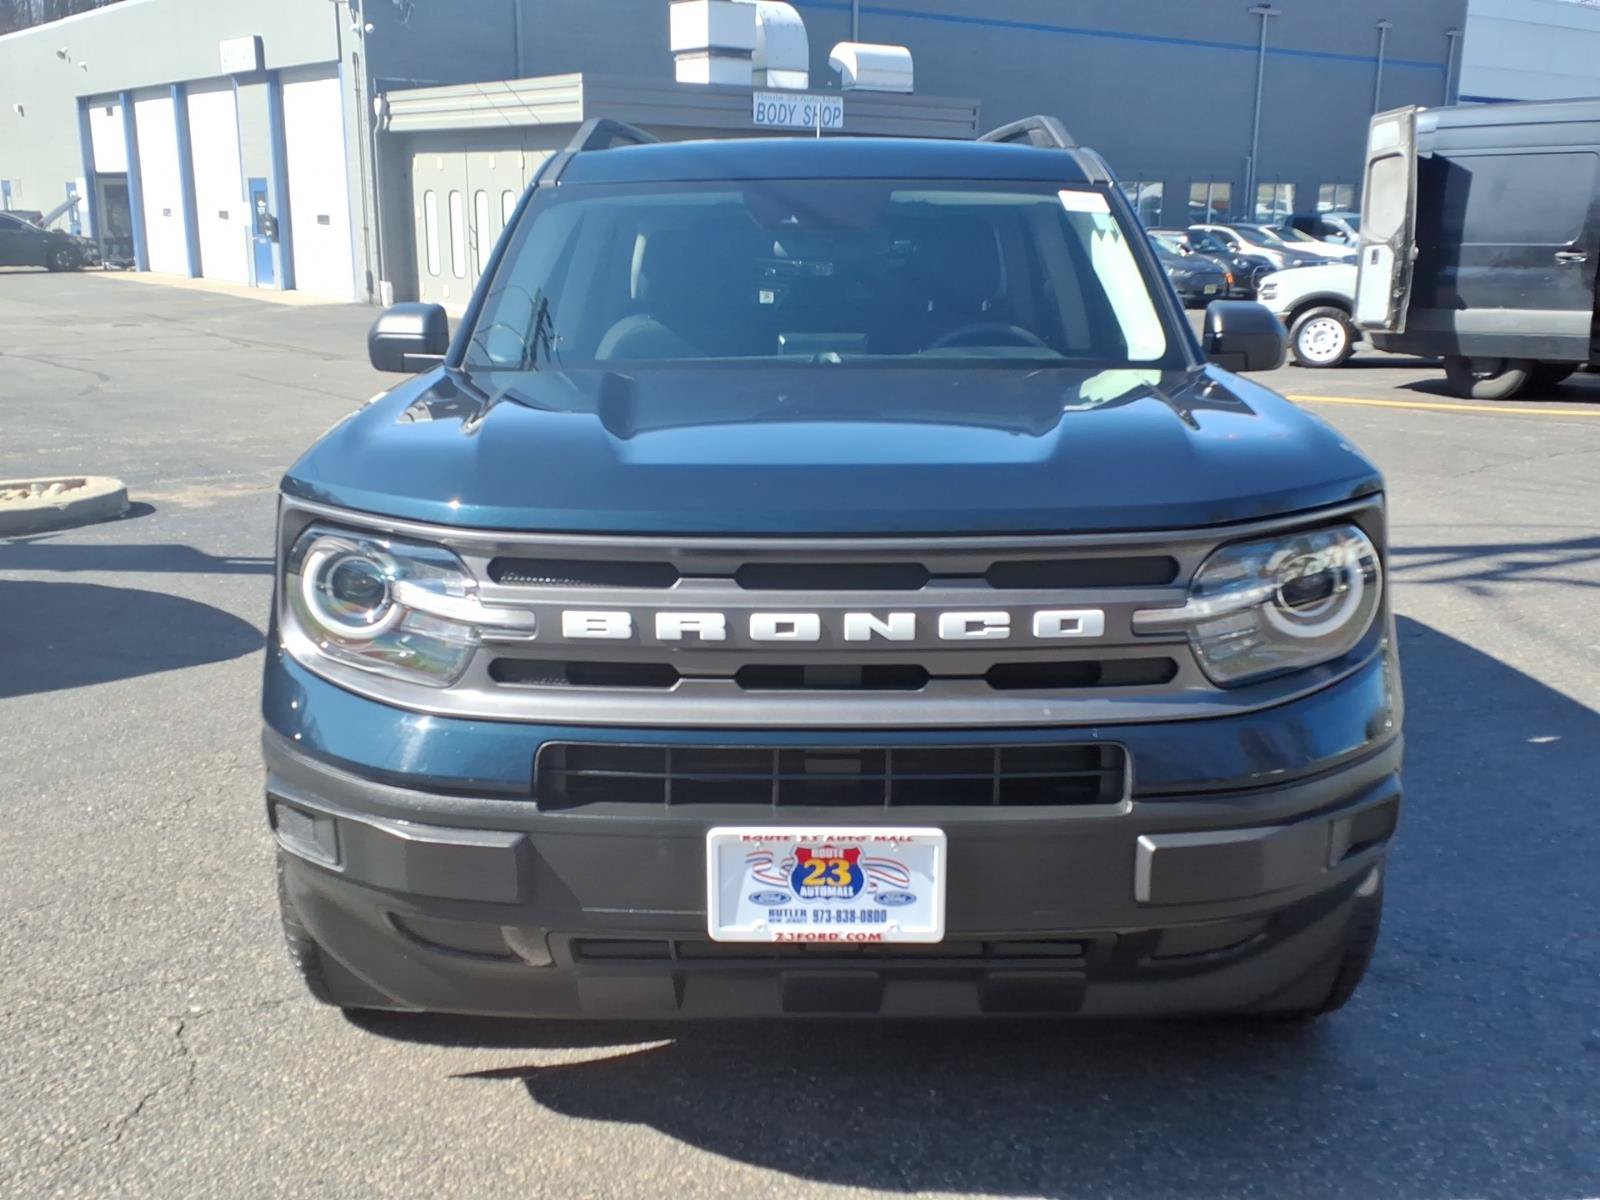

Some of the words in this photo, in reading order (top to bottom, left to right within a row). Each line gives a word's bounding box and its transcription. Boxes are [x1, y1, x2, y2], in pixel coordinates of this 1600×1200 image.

[756, 102, 797, 124] BODY
[802, 104, 841, 126] SHOP
[562, 609, 1105, 641] BRONCO
[742, 834, 791, 843] ROUTE
[826, 835, 866, 843] AUTO
[874, 834, 913, 843] MALL
[811, 848, 844, 859] ROUTE
[802, 858, 852, 886] 23
[800, 885, 855, 897] AUTOMALL
[768, 908, 807, 917] BUTLER
[812, 909, 887, 923] 973-838-0800
[774, 932, 883, 942] 23FORD.COM
